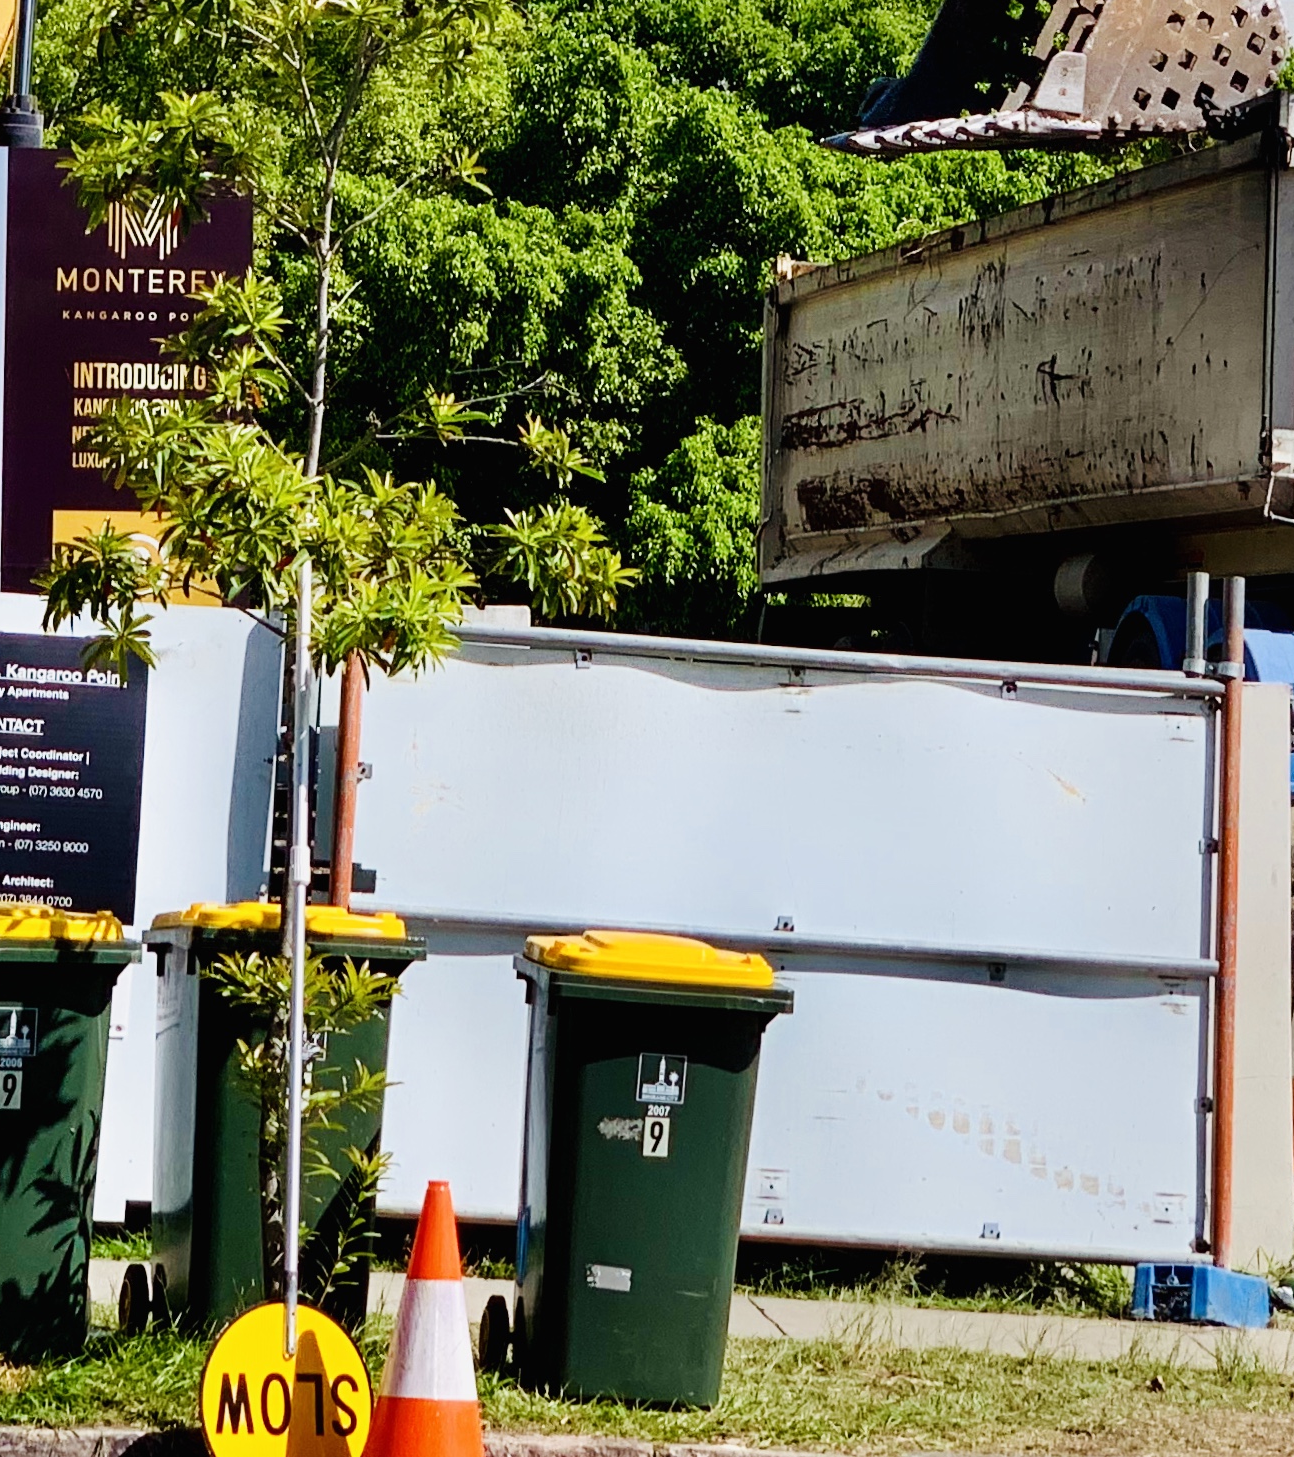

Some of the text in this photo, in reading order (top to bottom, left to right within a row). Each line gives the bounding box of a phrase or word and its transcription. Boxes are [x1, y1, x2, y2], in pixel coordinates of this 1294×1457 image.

[62, 310, 158, 321] KANGAROO
[6, 663, 83, 684] Kangaroo
[87, 668, 127, 688] Poin
[7, 685, 70, 701] Apartments
[21, 747, 84, 762] Coordinator
[28, 785, 48, 797] (07)
[49, 786, 76, 798] 3630
[77, 787, 103, 800] 4570
[14, 838, 33, 851] (07)
[35, 840, 61, 852] 3250
[63, 841, 89, 854] 9000
[46, 896, 73, 908] 0700
[2, 1073, 18, 1107] 9
[647, 1104, 671, 1117] 2007
[650, 1120, 664, 1153] 9
[215, 1372, 360, 1437] SLOW
